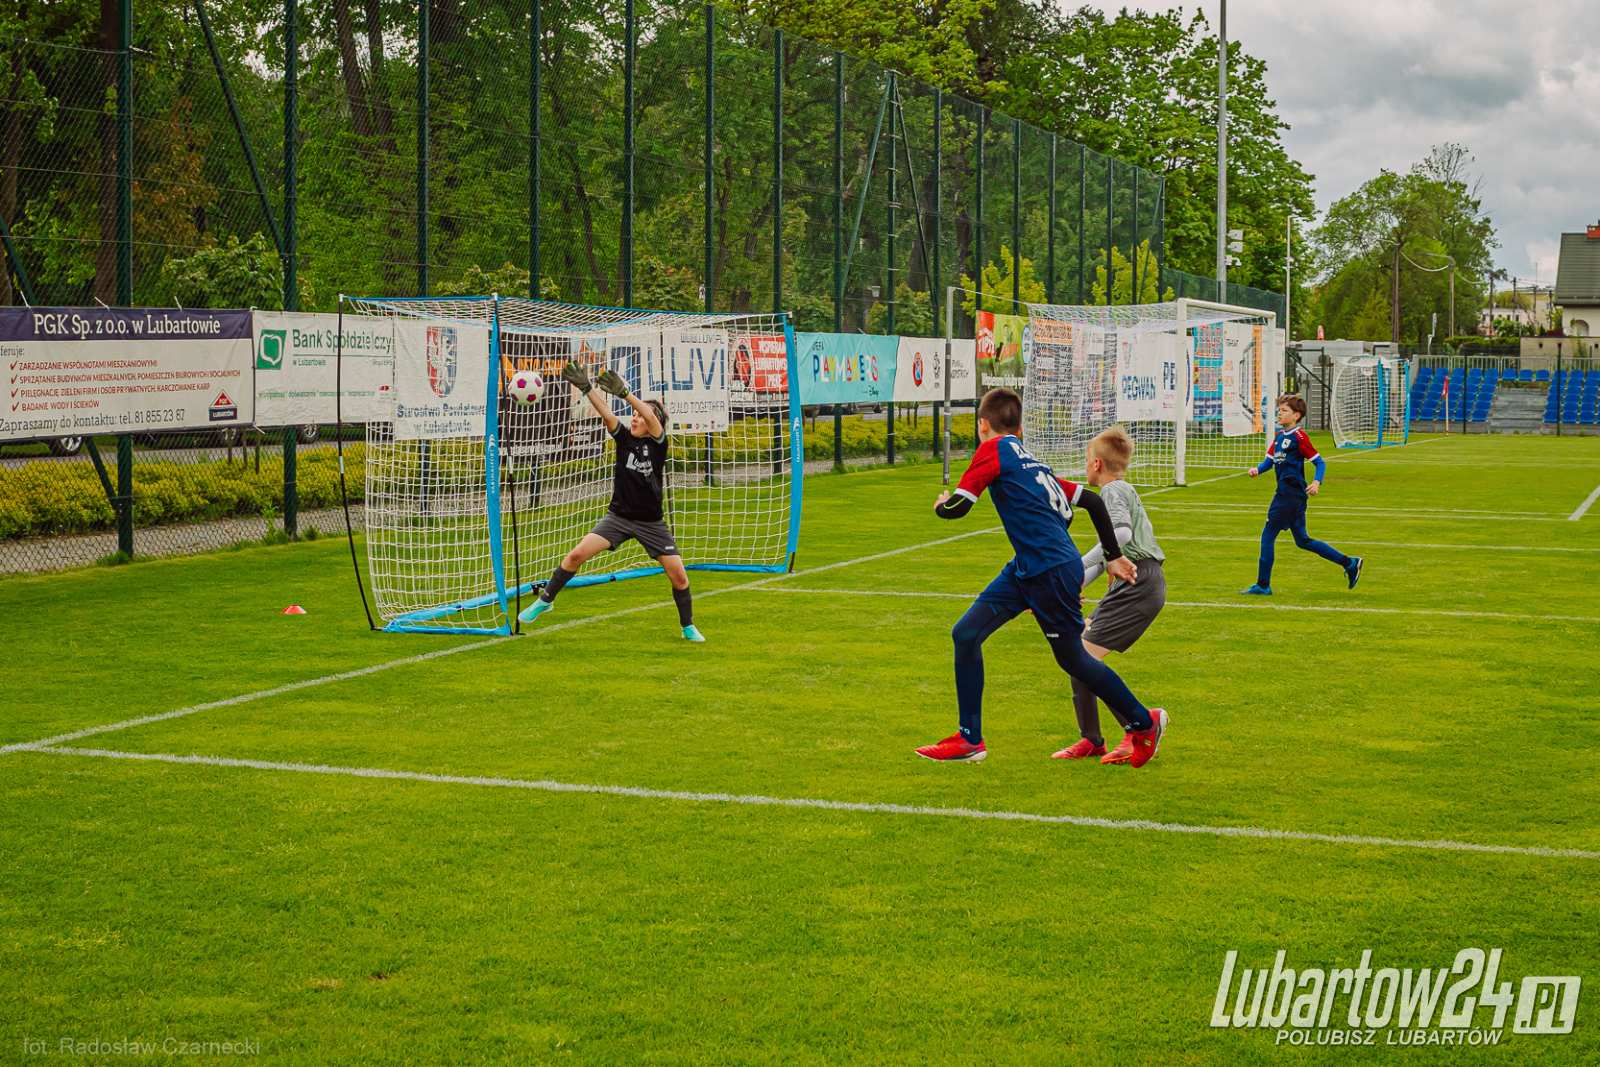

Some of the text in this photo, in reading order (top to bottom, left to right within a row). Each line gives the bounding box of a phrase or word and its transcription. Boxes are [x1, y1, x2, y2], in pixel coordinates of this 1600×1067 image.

[33, 313, 221, 339] PGK Sp. z o.o. w Lubartowie
[292, 329, 324, 349] Bank
[0, 346, 25, 358] feruje:
[19, 362, 62, 371] ZARZĄDZANIE
[813, 352, 879, 384] PLAYMAKERS
[0, 417, 59, 434] Zapraszamy
[60, 415, 71, 428] do
[135, 411, 144, 424] 81
[145, 410, 161, 423] 855
[163, 409, 174, 422] 23
[175, 408, 185, 421] 87
